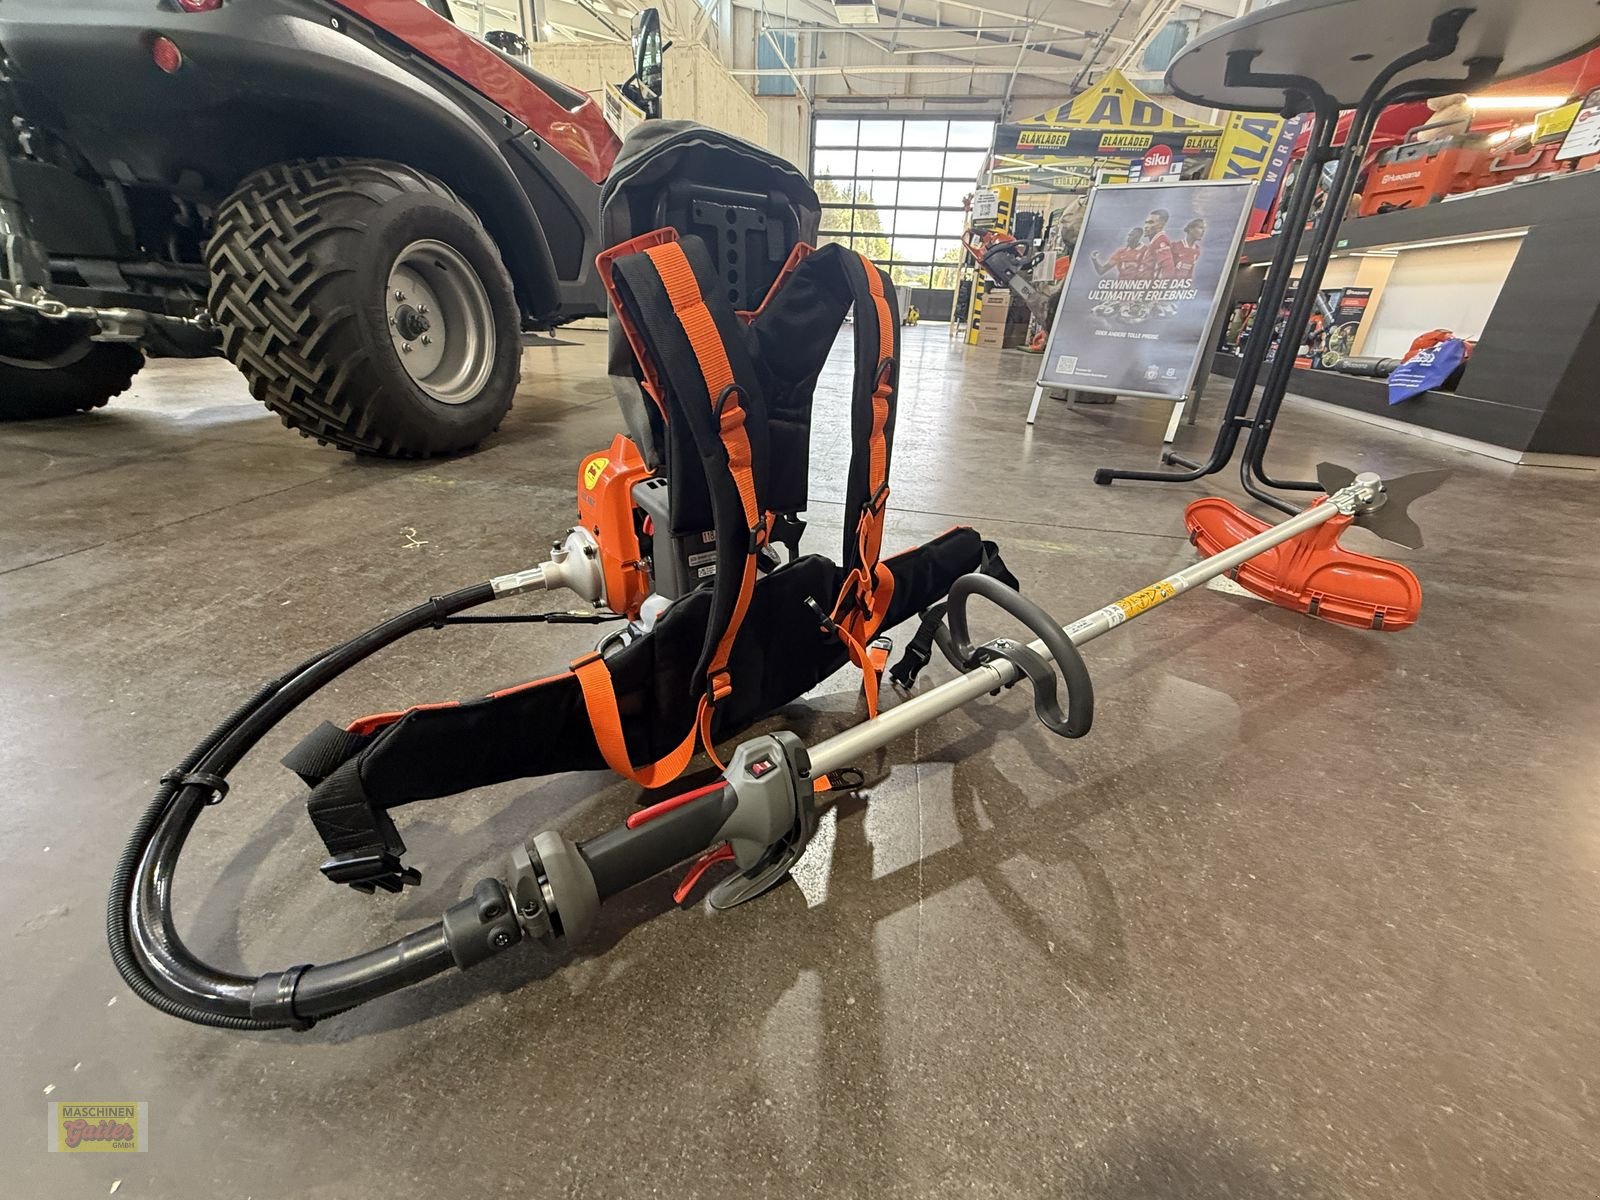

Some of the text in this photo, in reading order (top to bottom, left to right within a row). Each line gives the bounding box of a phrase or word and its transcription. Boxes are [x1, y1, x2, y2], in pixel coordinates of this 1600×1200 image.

[1144, 153, 1170, 167] siku
[1098, 278, 1193, 290] GEWINNEN SIE DAS
[1088, 289, 1198, 300] ULTIMATIVE ERLEBNIS!
